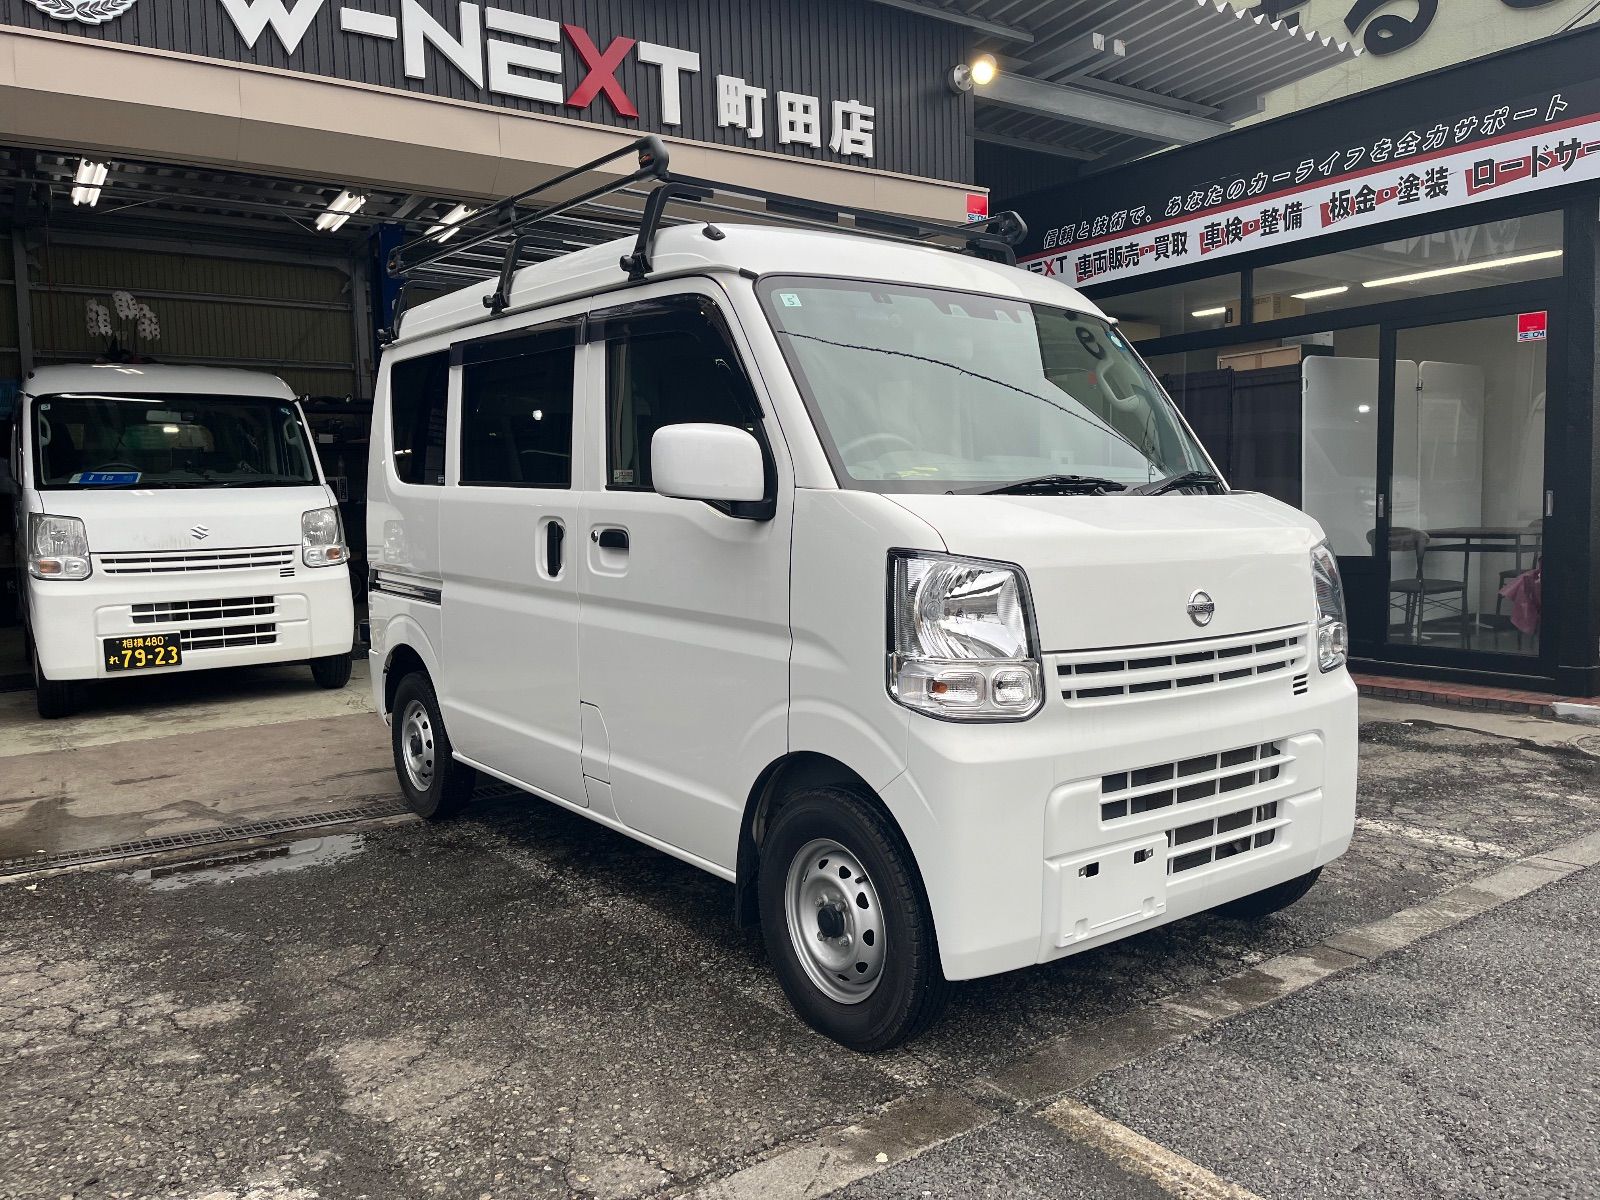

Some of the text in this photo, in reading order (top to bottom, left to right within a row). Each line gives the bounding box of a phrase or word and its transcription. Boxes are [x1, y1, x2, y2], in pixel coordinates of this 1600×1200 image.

[220, 0, 875, 158] W-NEXT 町田店
[1027, 255, 1068, 277] EXT
[109, 646, 178, 668] れ 79-23
